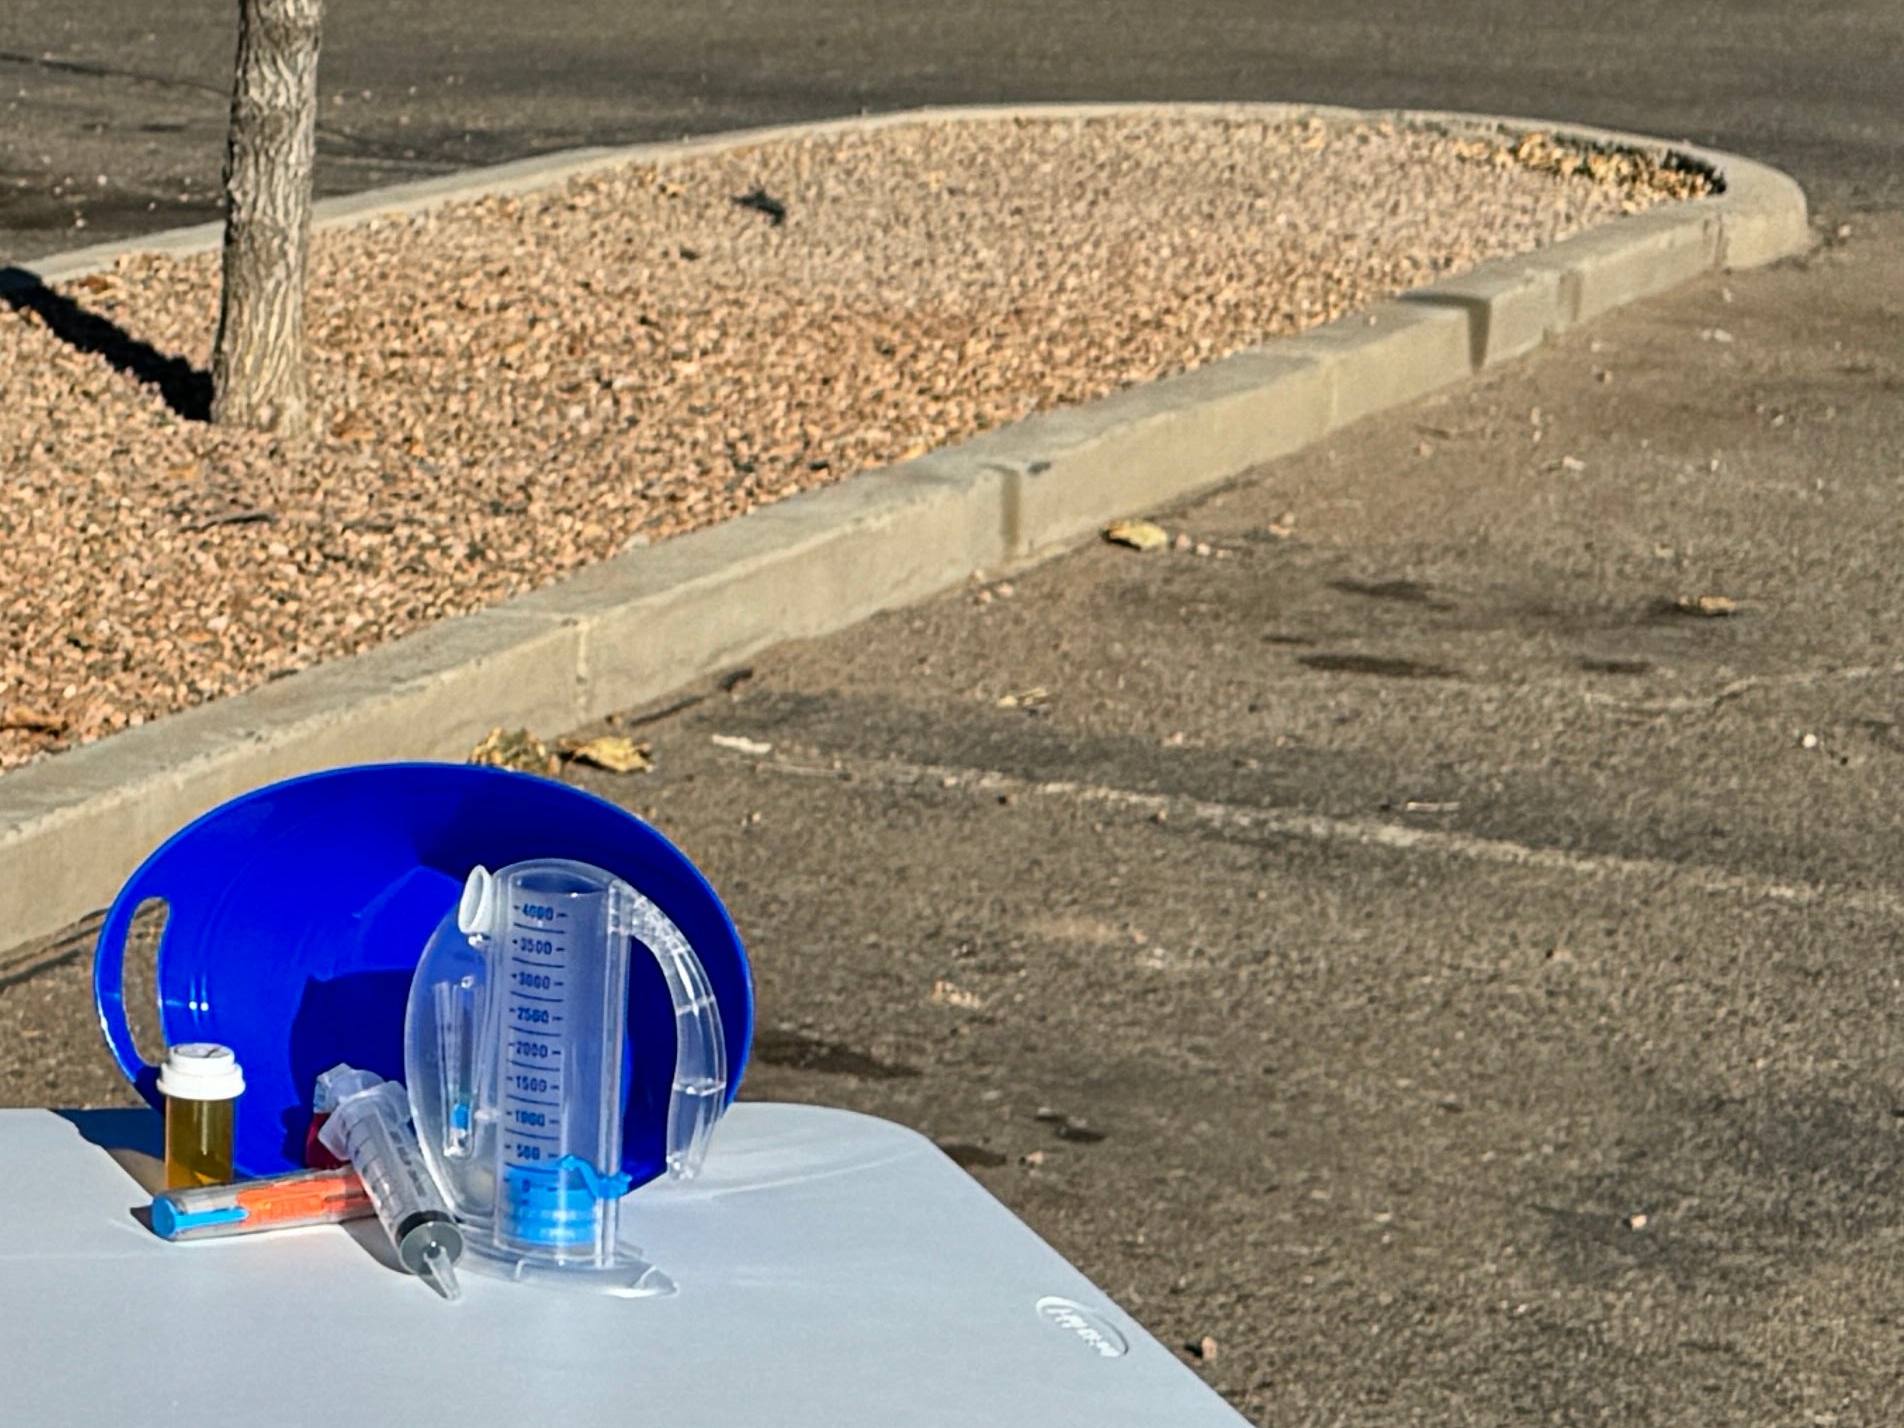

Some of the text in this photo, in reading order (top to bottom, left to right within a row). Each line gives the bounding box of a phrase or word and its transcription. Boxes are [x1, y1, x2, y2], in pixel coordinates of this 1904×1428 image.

[523, 903, 554, 921] 4000
[520, 937, 552, 955] 3500
[519, 971, 551, 990] 3000
[517, 1006, 549, 1024] 2500
[515, 1041, 548, 1059] 2000
[515, 1075, 547, 1093] 1500
[514, 1109, 546, 1127] 1000
[516, 1143, 541, 1160] 500
